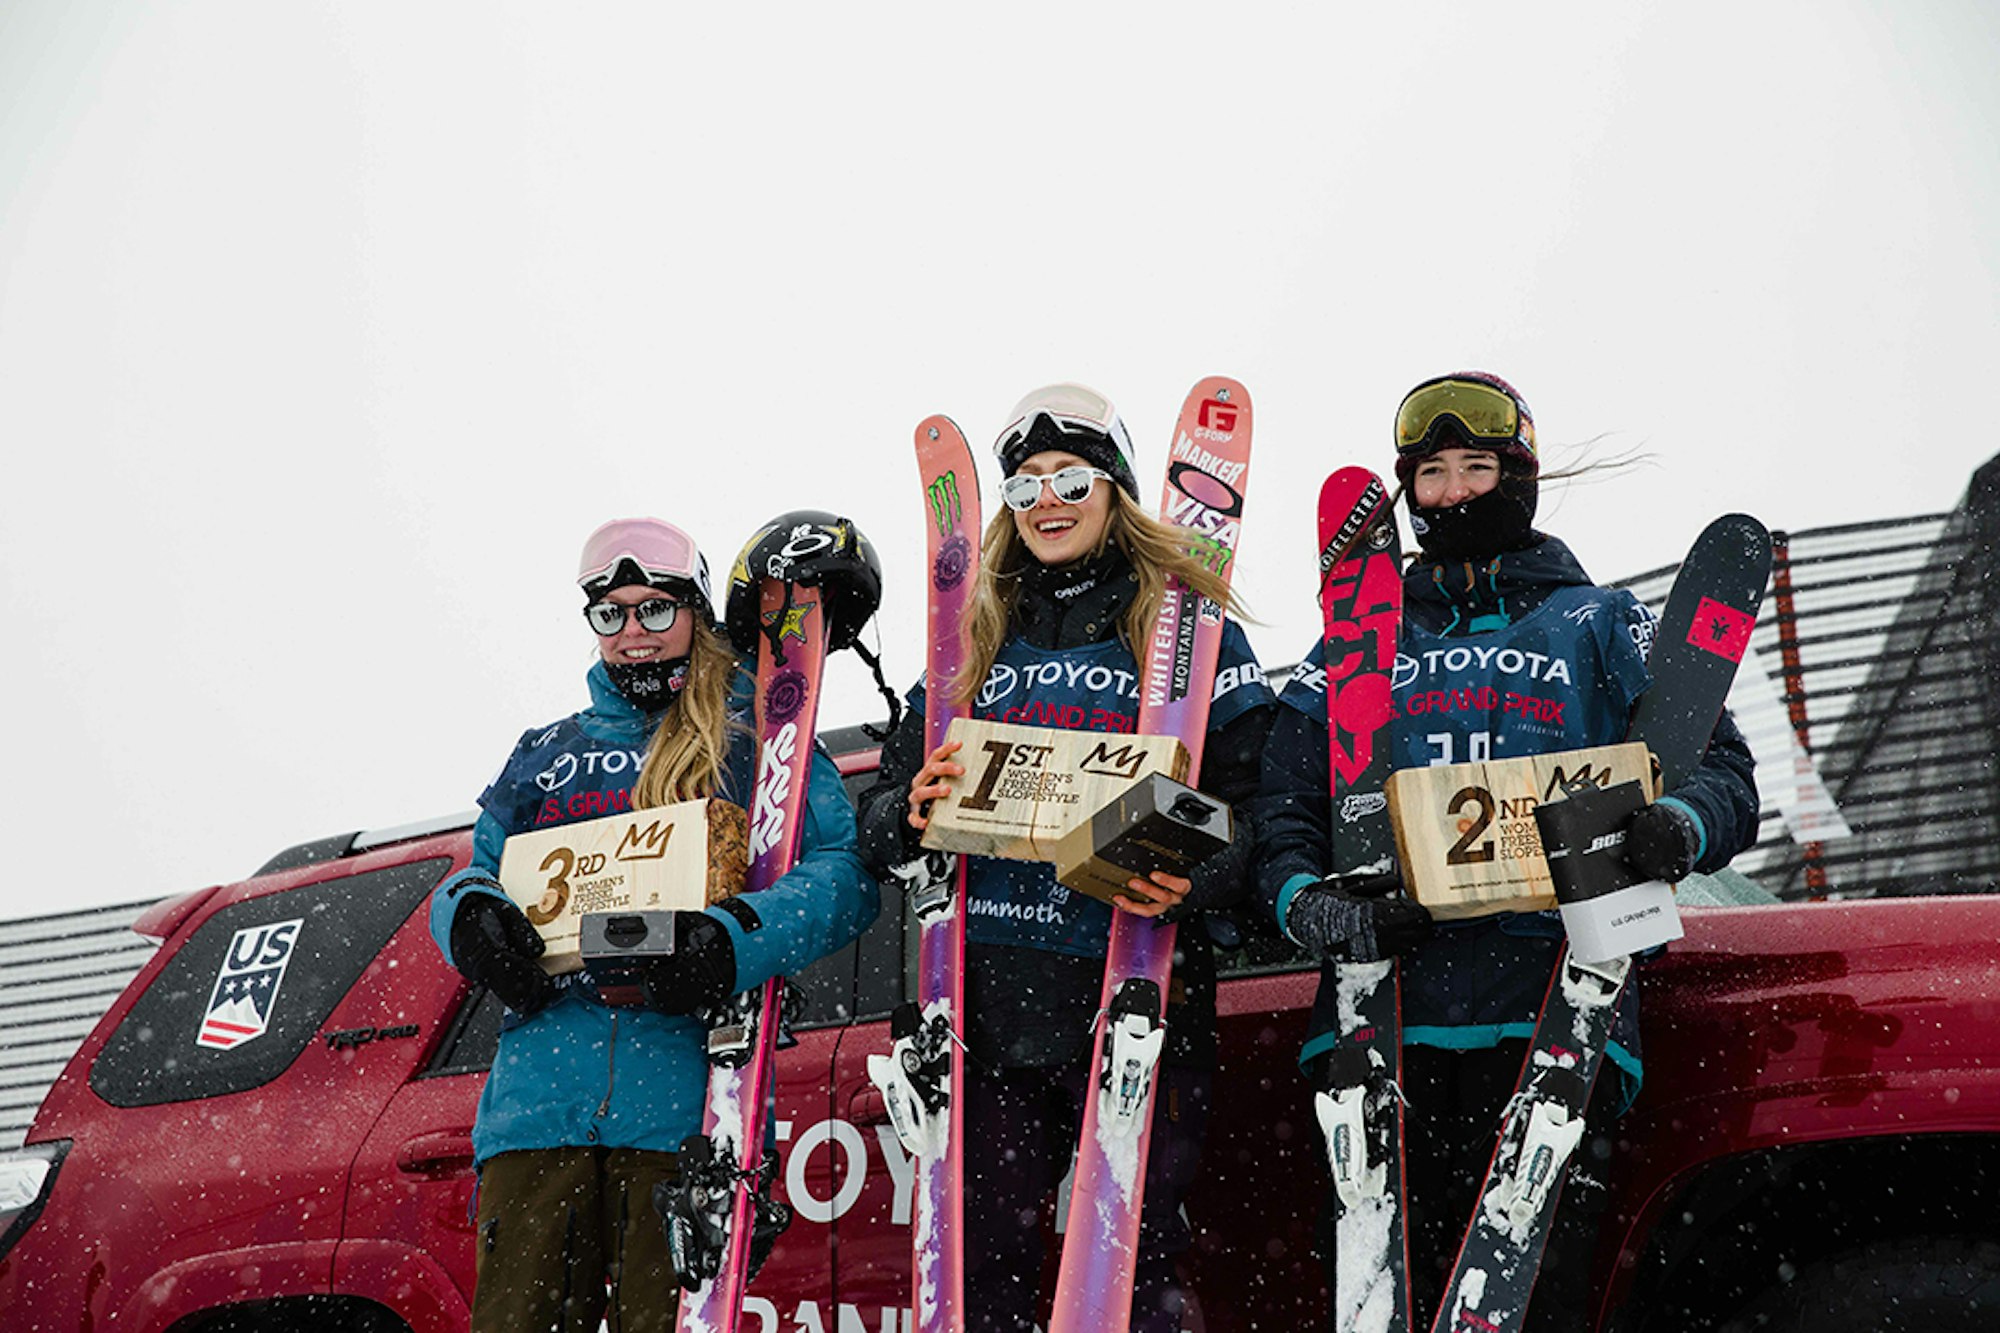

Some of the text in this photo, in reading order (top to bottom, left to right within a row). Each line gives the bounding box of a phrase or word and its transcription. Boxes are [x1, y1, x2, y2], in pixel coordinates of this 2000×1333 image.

[1194, 427, 1232, 443] G-FORM
[1173, 430, 1246, 486] MARKER
[1166, 486, 1240, 550] VISA
[1148, 589, 1178, 707] WHITEFISH
[1174, 615, 1194, 690] MONTANA
[1291, 660, 1329, 694] SE
[1423, 646, 1572, 686] TOYOTA
[1406, 686, 1498, 716] GRAND
[582, 750, 652, 775] TOY
[1007, 769, 1074, 784] WOMEN'S
[567, 787, 637, 817] GRAN
[1500, 822, 1538, 836] WOM
[1582, 829, 1627, 855] BOS
[228, 925, 297, 971] US
[323, 1026, 375, 1052] TRD
